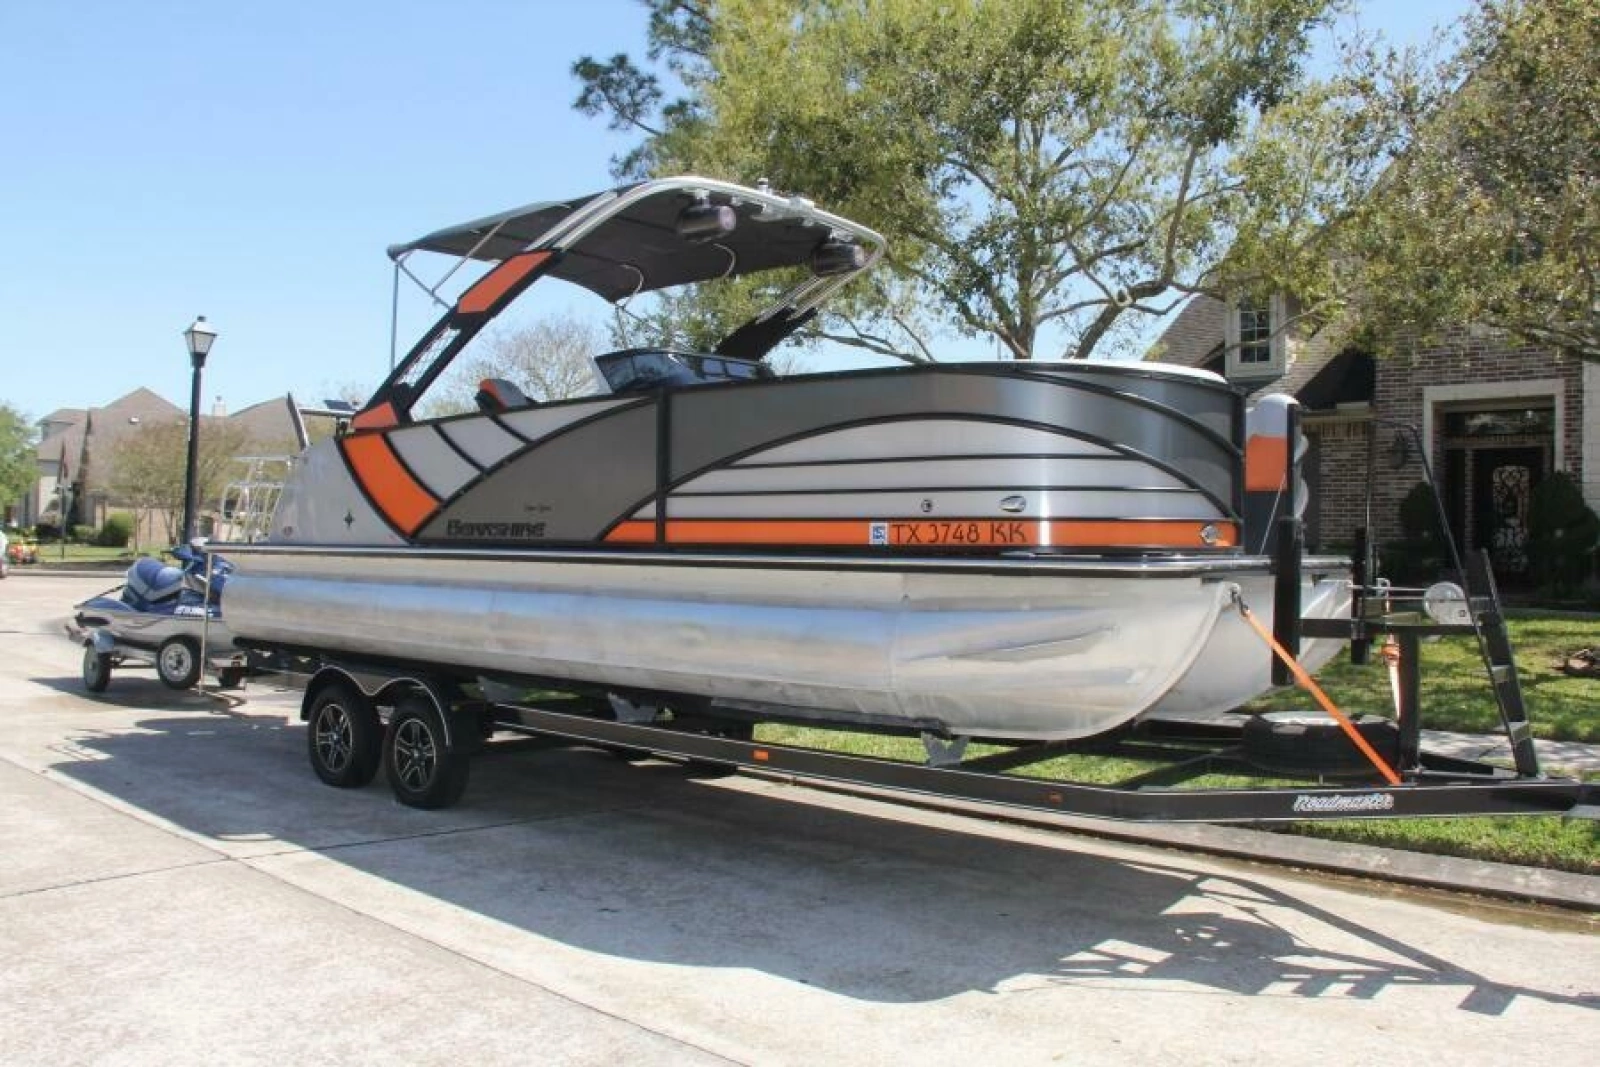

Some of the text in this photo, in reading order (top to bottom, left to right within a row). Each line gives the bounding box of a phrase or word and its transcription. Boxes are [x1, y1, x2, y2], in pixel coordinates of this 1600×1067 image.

[891, 523, 921, 544] TX
[927, 523, 981, 544] 3748
[989, 522, 1027, 544] KK
